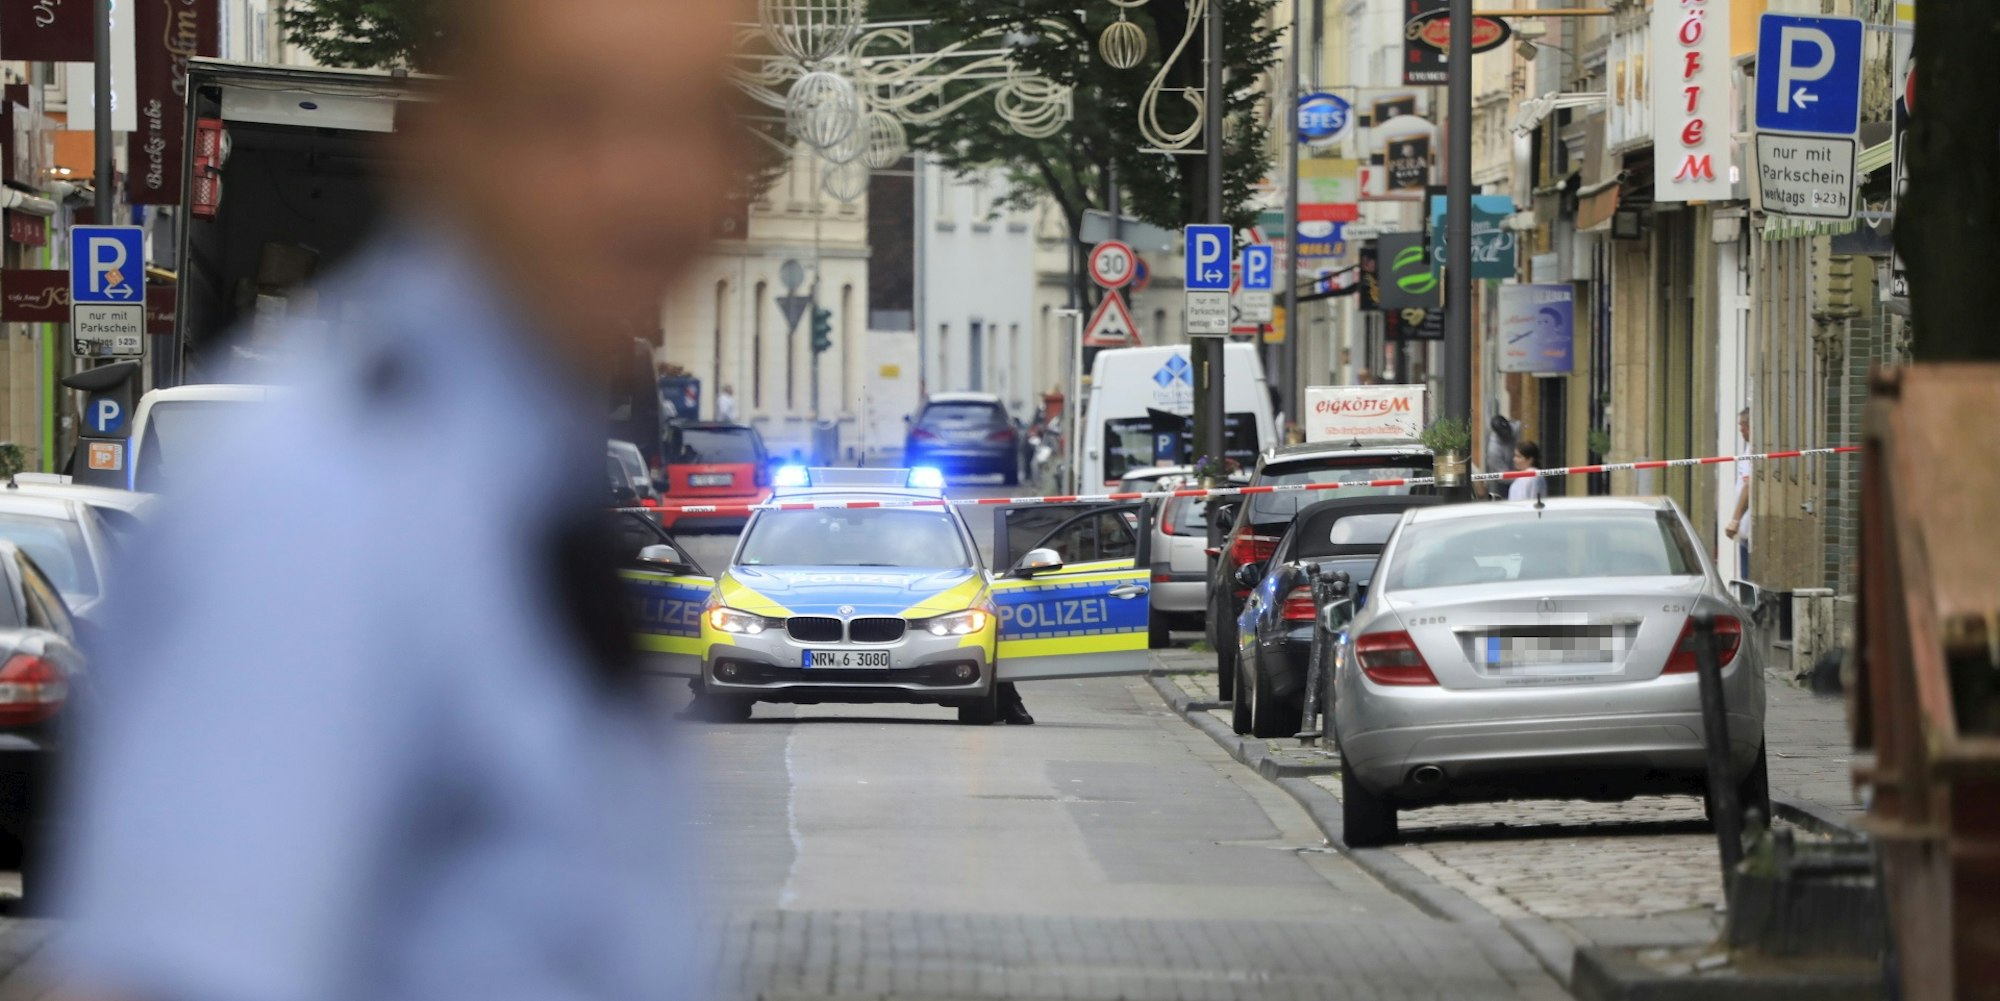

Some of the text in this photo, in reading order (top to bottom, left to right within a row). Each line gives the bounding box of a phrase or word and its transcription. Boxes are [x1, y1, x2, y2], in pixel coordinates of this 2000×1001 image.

[1776, 25, 1836, 114] P
[1673, 0, 1715, 182] ÖFTEM
[1297, 111, 1343, 129] EFES
[144, 99, 166, 190] Backsube
[1772, 147, 1831, 162] nur mit
[1763, 164, 1845, 185] Parkschein
[1764, 187, 1805, 206] werktags
[89, 236, 127, 293] P
[1101, 254, 1125, 275] 30
[1195, 233, 1221, 282] P
[1248, 250, 1268, 285] P
[89, 311, 128, 321] nur mit
[80, 323, 137, 333] Parkschein
[98, 399, 120, 431] P
[1157, 434, 1171, 452] P
[997, 598, 1108, 630] POLIZEI
[811, 652, 836, 666] NRW
